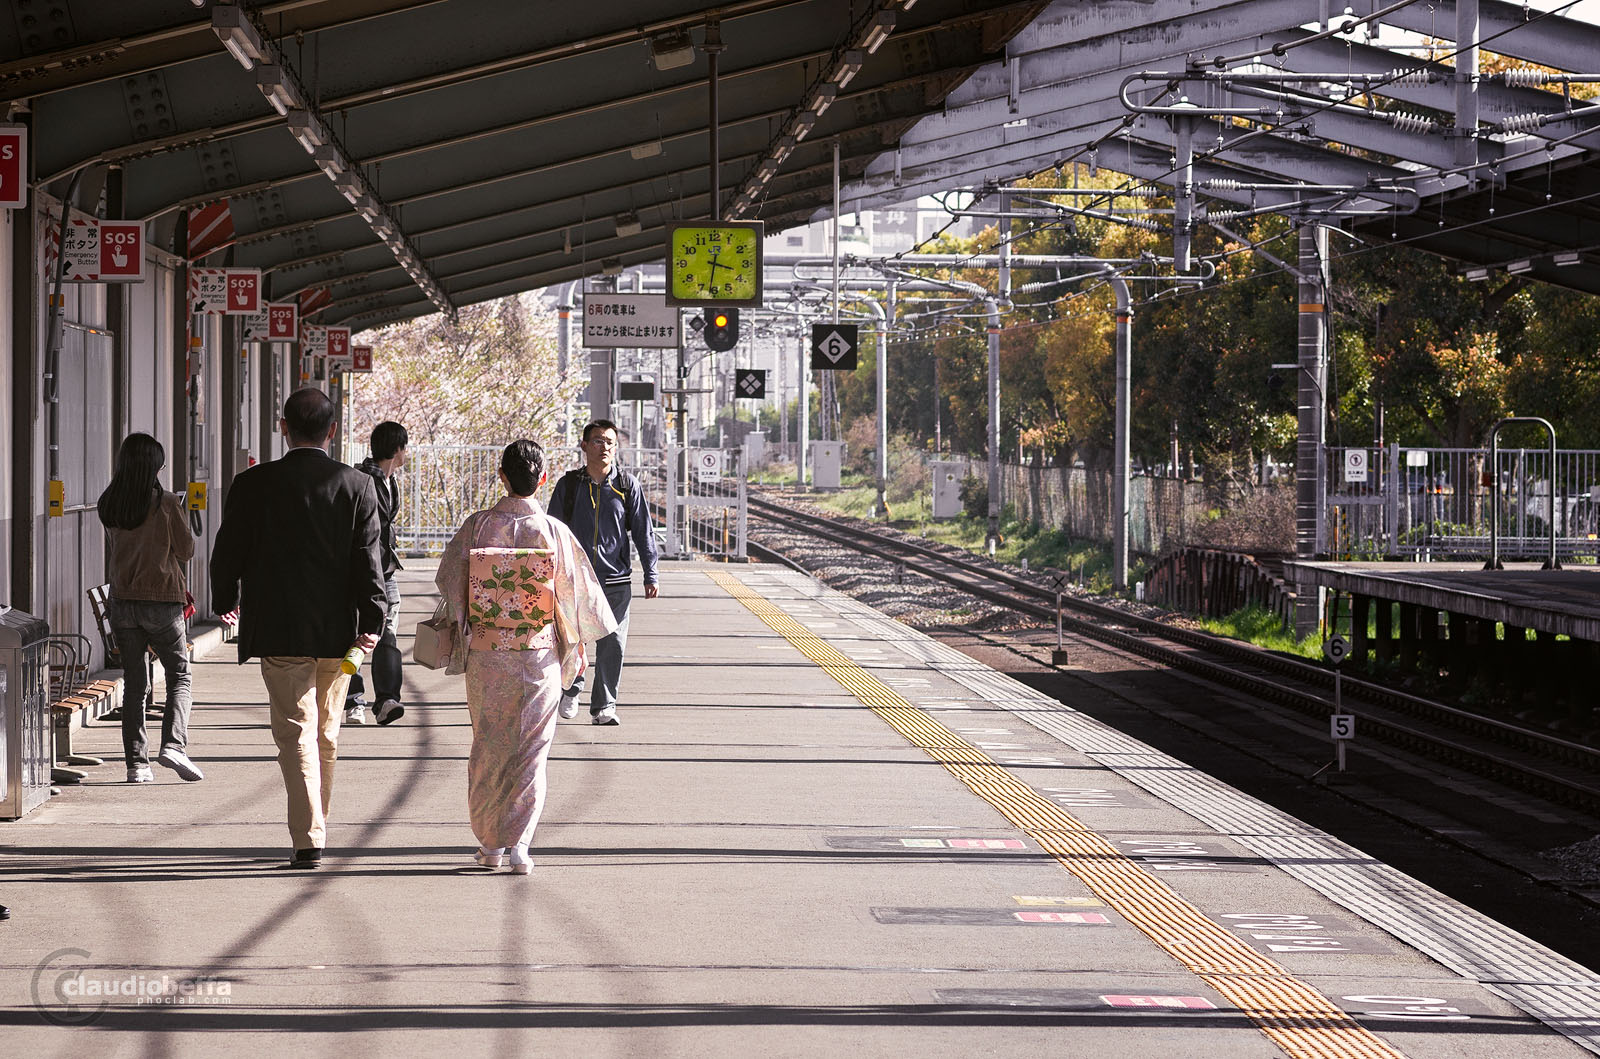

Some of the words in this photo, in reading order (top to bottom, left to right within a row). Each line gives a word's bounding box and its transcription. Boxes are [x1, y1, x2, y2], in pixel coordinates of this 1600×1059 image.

[105, 232, 136, 244] SOS
[696, 237, 706, 245] 11
[709, 233, 720, 241] 12
[726, 236, 731, 245] 1
[65, 240, 98, 250] ボタン
[736, 245, 744, 254] 2
[64, 251, 98, 259] Emergency
[685, 246, 696, 255] 10
[680, 259, 687, 268] 9
[742, 259, 750, 268] 3
[685, 274, 693, 282] 8
[735, 273, 743, 282] 4
[201, 284, 226, 292] ボタン
[230, 279, 254, 288] SOS
[697, 283, 705, 291] 7
[724, 283, 733, 291] 5
[711, 286, 719, 295] 6
[588, 303, 636, 316] 6両の電車は
[272, 310, 292, 319] SOS
[588, 325, 674, 337] ここから後に止まります
[828, 338, 841, 357] 6
[1330, 638, 1344, 657] 6
[1336, 717, 1349, 736] 5
